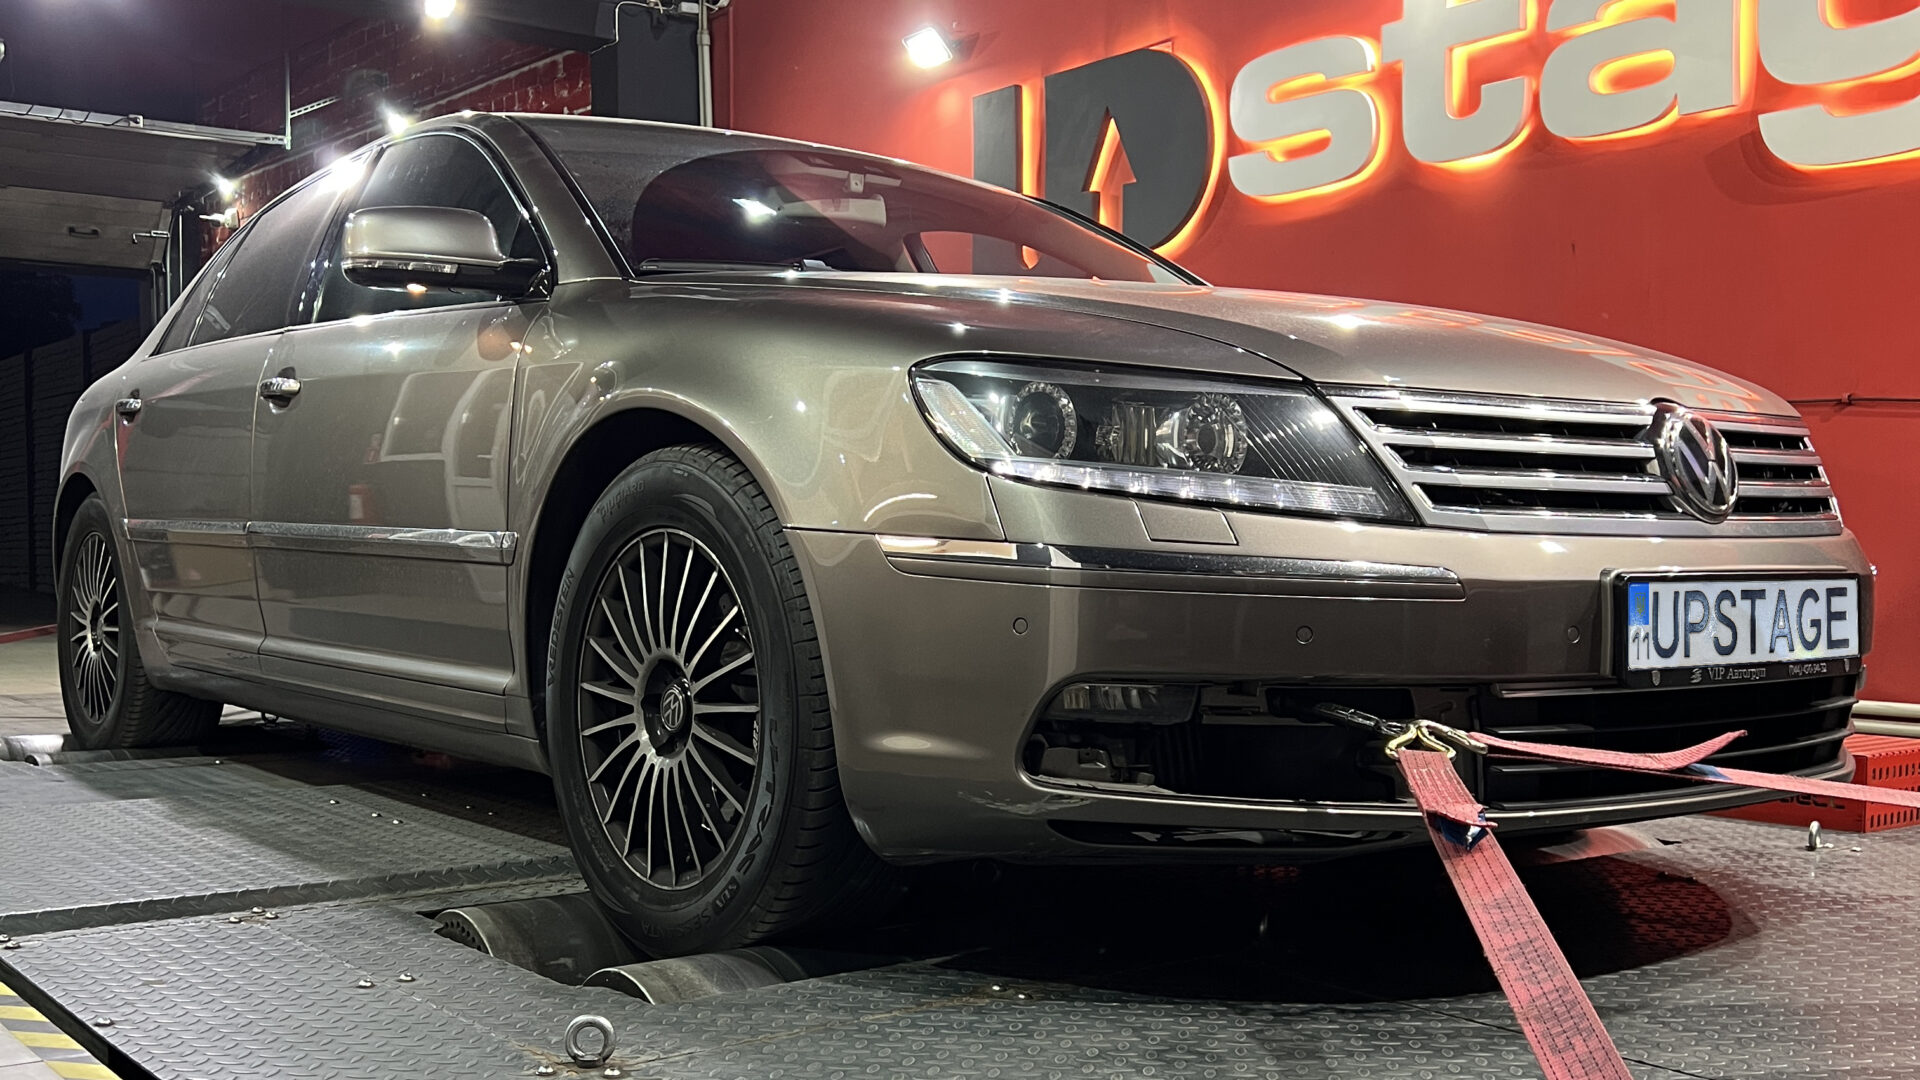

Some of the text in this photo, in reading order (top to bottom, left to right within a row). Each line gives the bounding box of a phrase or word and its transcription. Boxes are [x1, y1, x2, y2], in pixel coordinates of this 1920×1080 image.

[547, 568, 575, 686] VREDESTEIN
[1652, 586, 1850, 659] UPSTAGE
[1708, 667, 1726, 681] VIP
